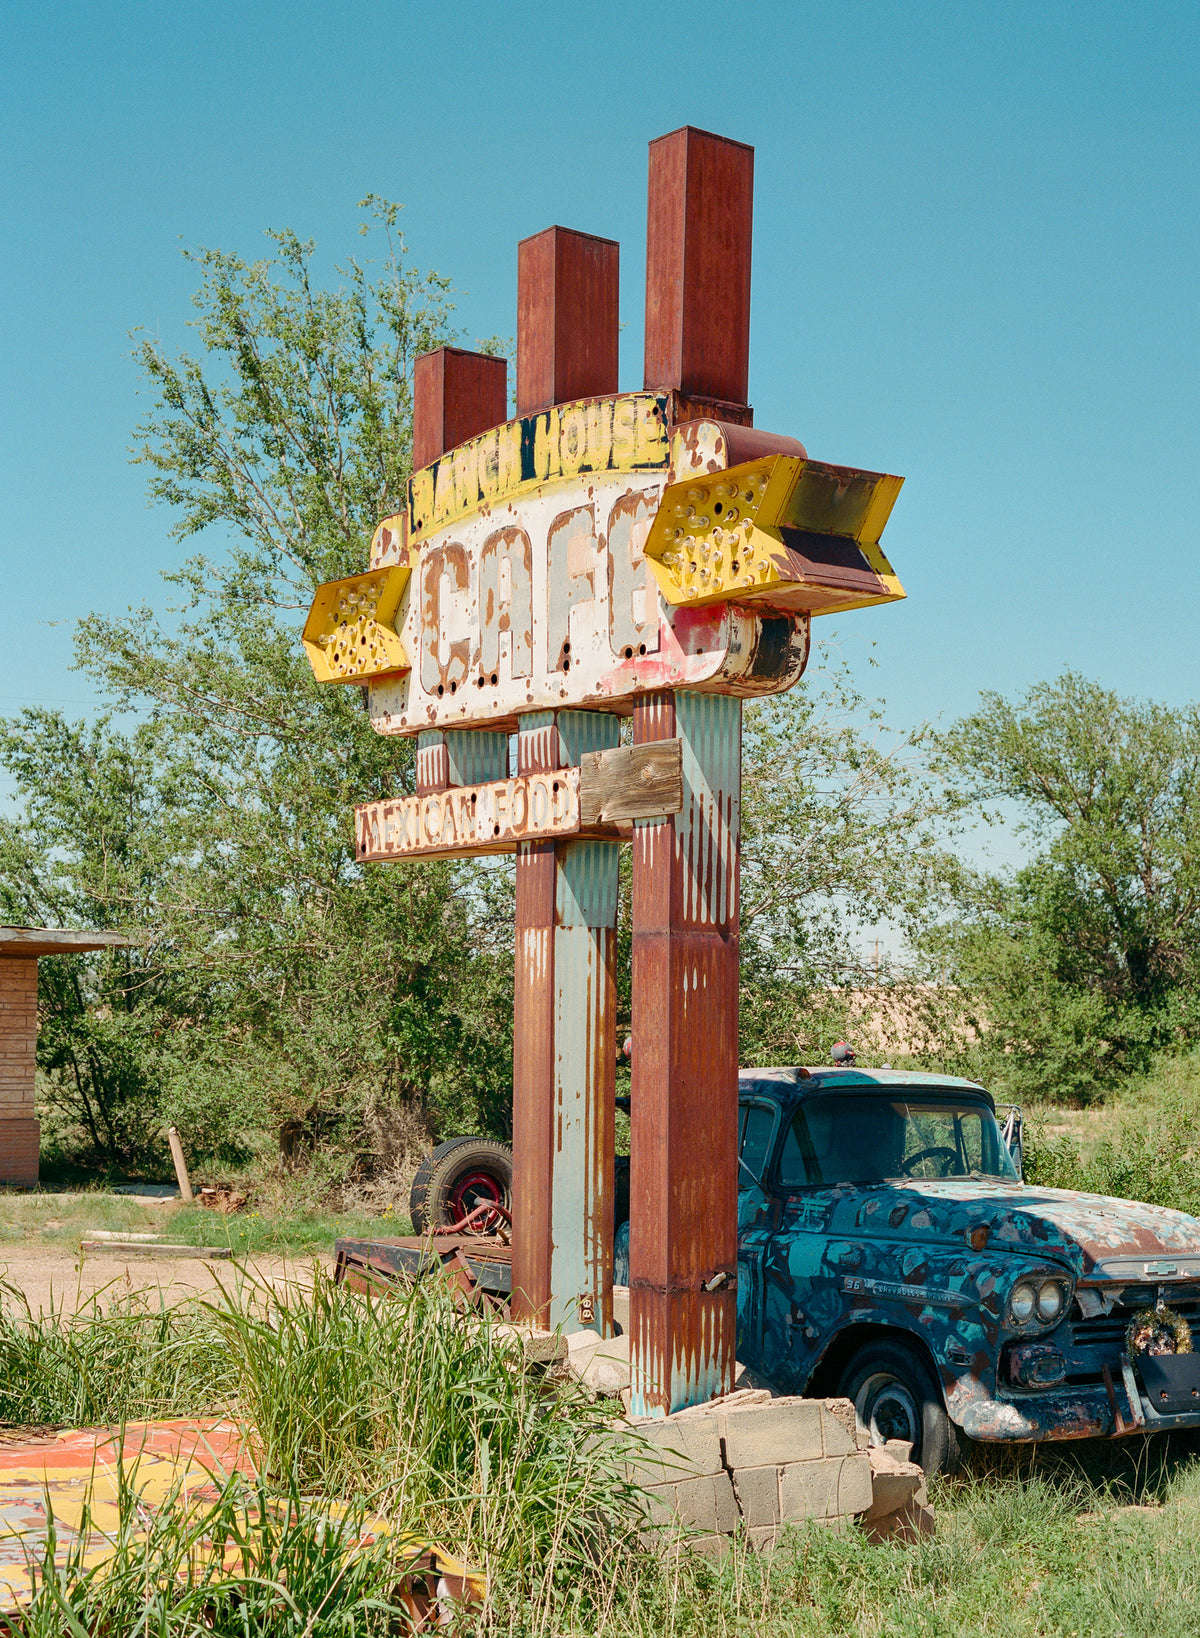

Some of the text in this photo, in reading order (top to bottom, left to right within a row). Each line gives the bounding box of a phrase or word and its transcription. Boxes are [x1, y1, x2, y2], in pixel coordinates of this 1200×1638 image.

[534, 397, 669, 480] HOUSE
[419, 484, 661, 696] CAFE
[359, 779, 570, 853] MEXICAN FOOD
[846, 1279, 861, 1291] 36
